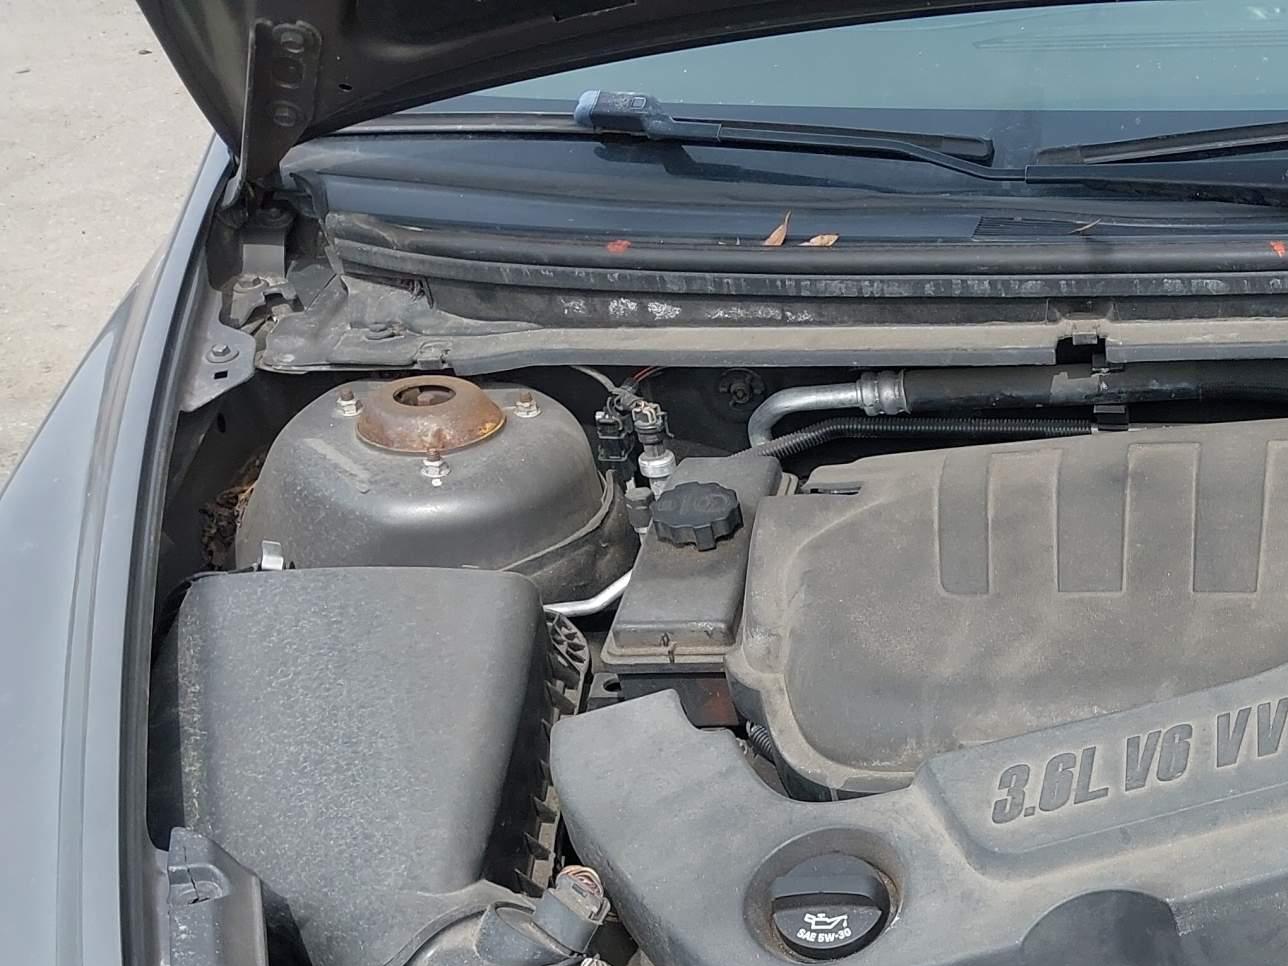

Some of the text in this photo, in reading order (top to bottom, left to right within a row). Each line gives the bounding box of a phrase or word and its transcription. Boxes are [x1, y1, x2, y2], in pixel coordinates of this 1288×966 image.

[991, 745, 1109, 824] 3.6L
[1125, 722, 1194, 792] V6
[797, 928, 852, 943] SAE 5W-30
